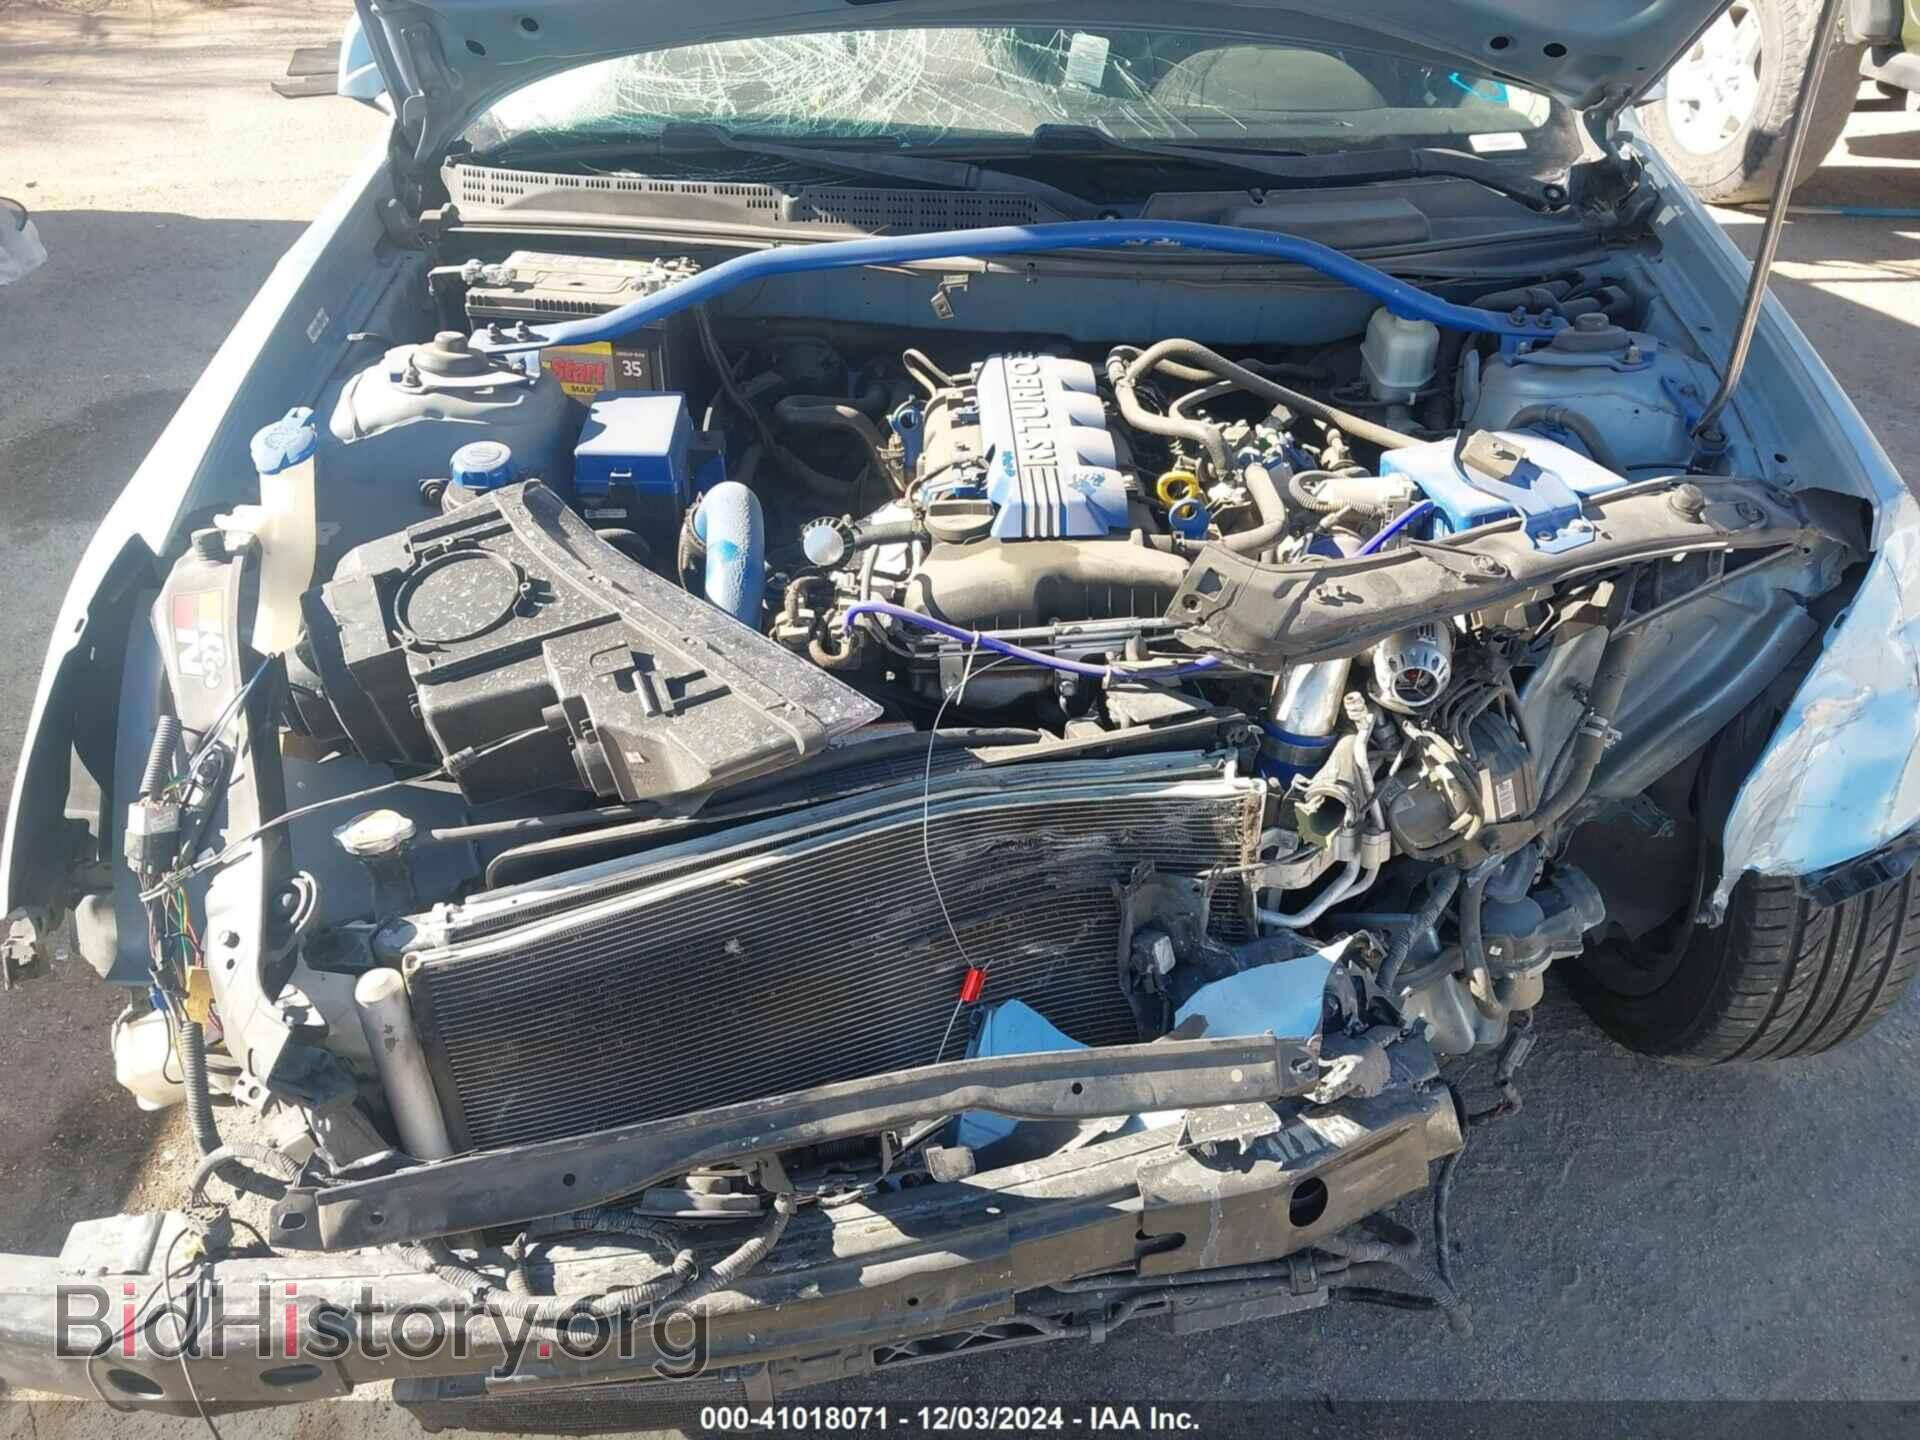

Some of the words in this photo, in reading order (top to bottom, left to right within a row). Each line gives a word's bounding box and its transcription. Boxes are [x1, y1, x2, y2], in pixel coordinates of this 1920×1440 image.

[622, 360, 642, 377] 35
[1010, 362, 1051, 434] TURBO
[1022, 440, 1059, 468] RS
